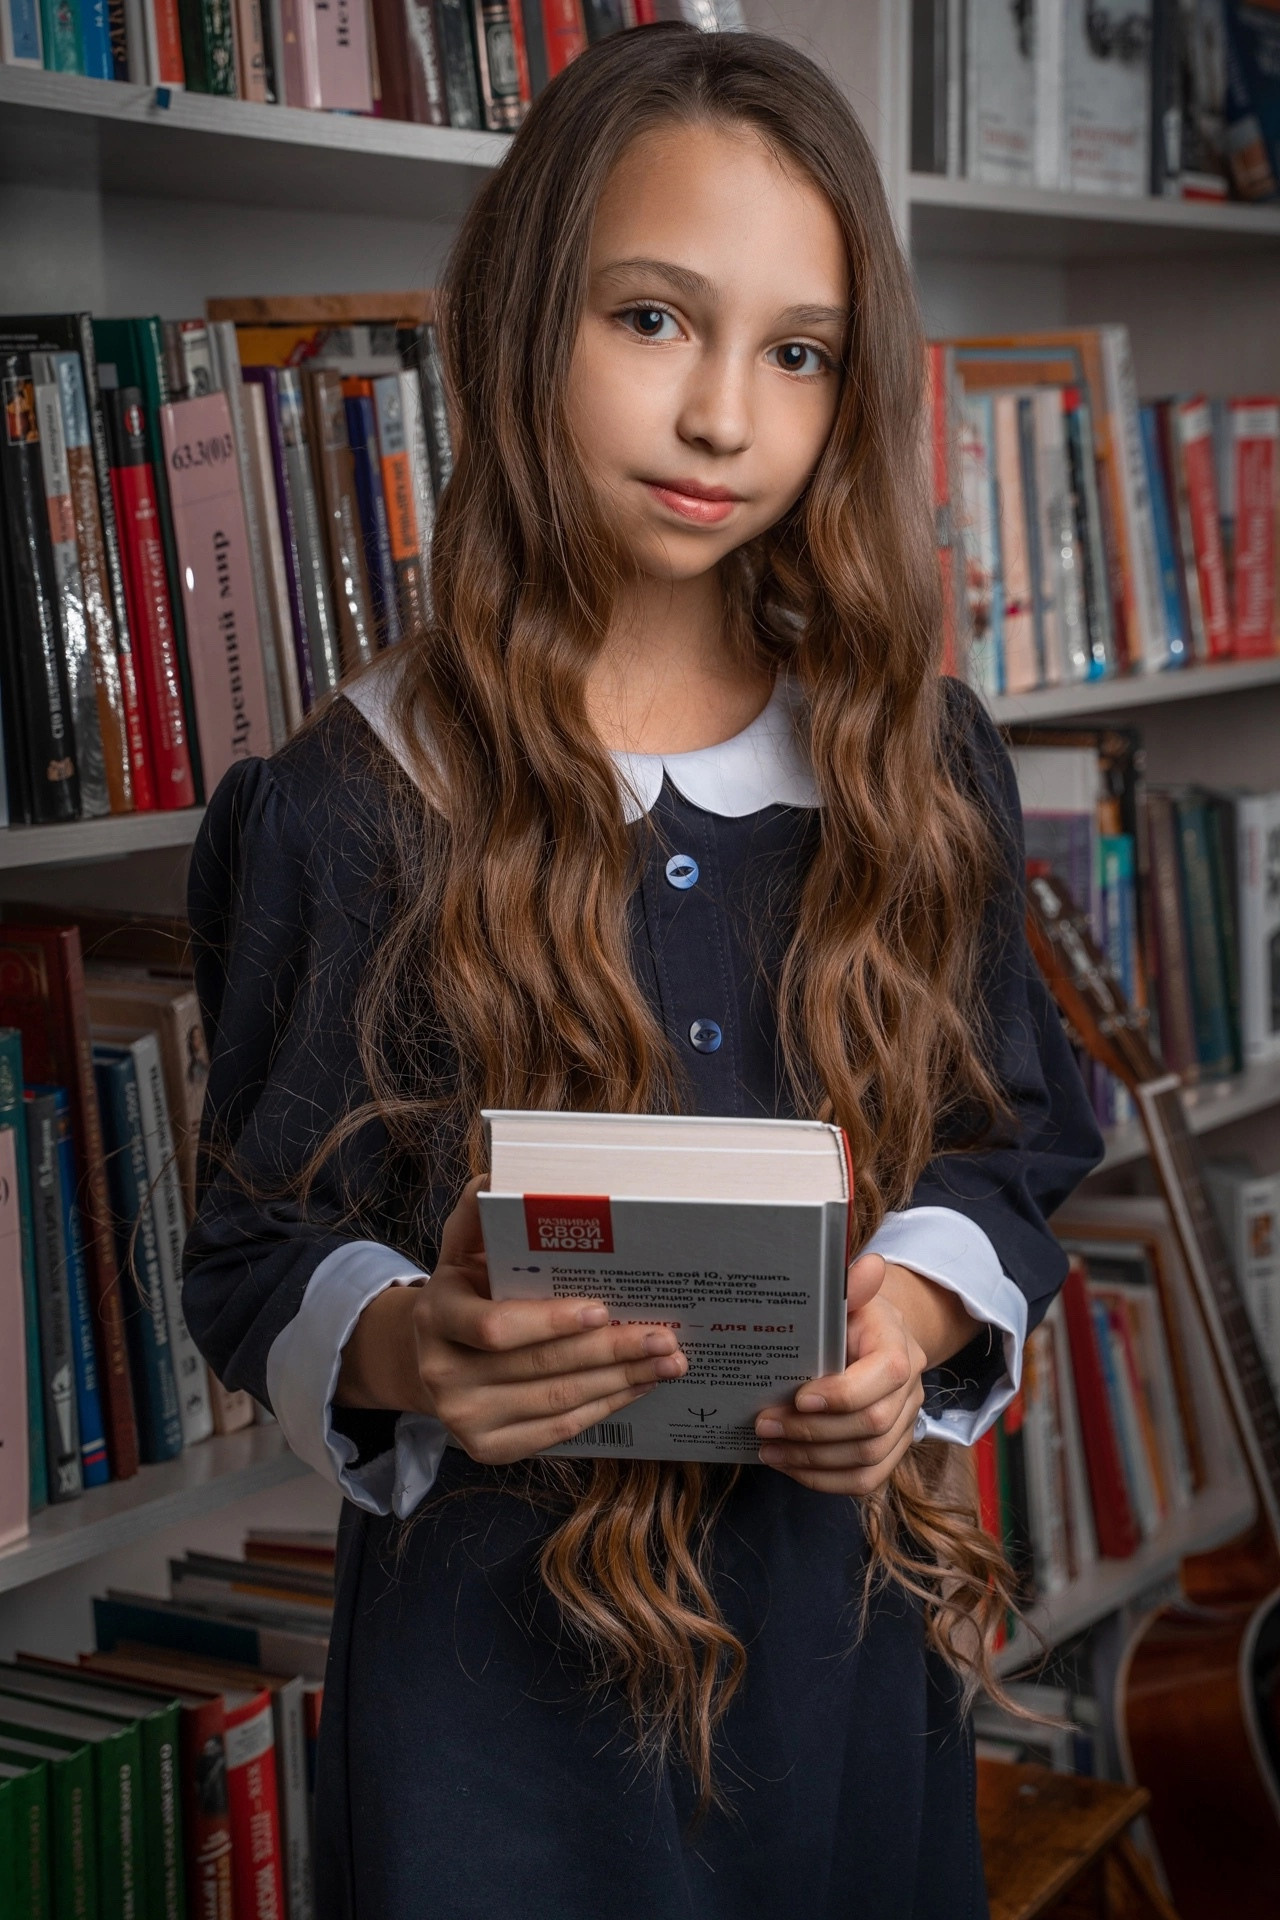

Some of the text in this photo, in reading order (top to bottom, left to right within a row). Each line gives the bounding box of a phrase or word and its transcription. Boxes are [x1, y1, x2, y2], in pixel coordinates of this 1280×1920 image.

[213, 530, 252, 756] Древний мир
[537, 1217, 600, 1227] РАЗВИВАЙ
[538, 1225, 602, 1238] СВОЙ
[540, 1238, 604, 1249] МОЗГ
[551, 1267, 596, 1275] Хотите
[600, 1269, 664, 1277] повысить
[668, 1270, 700, 1278] свой
[616, 1278, 689, 1286] внимание?
[694, 1280, 757, 1288] Мечтаете
[656, 1287, 732, 1295] творческий
[554, 1291, 623, 1299] пробудить
[627, 1294, 693, 1302] интуицию
[603, 1301, 697, 1309] подсознания?
[710, 1323, 747, 1332] для
[753, 1324, 794, 1333] вас!
[730, 1343, 800, 1351] позволяют
[707, 1358, 769, 1366] активную
[710, 1379, 773, 1387] решений!
